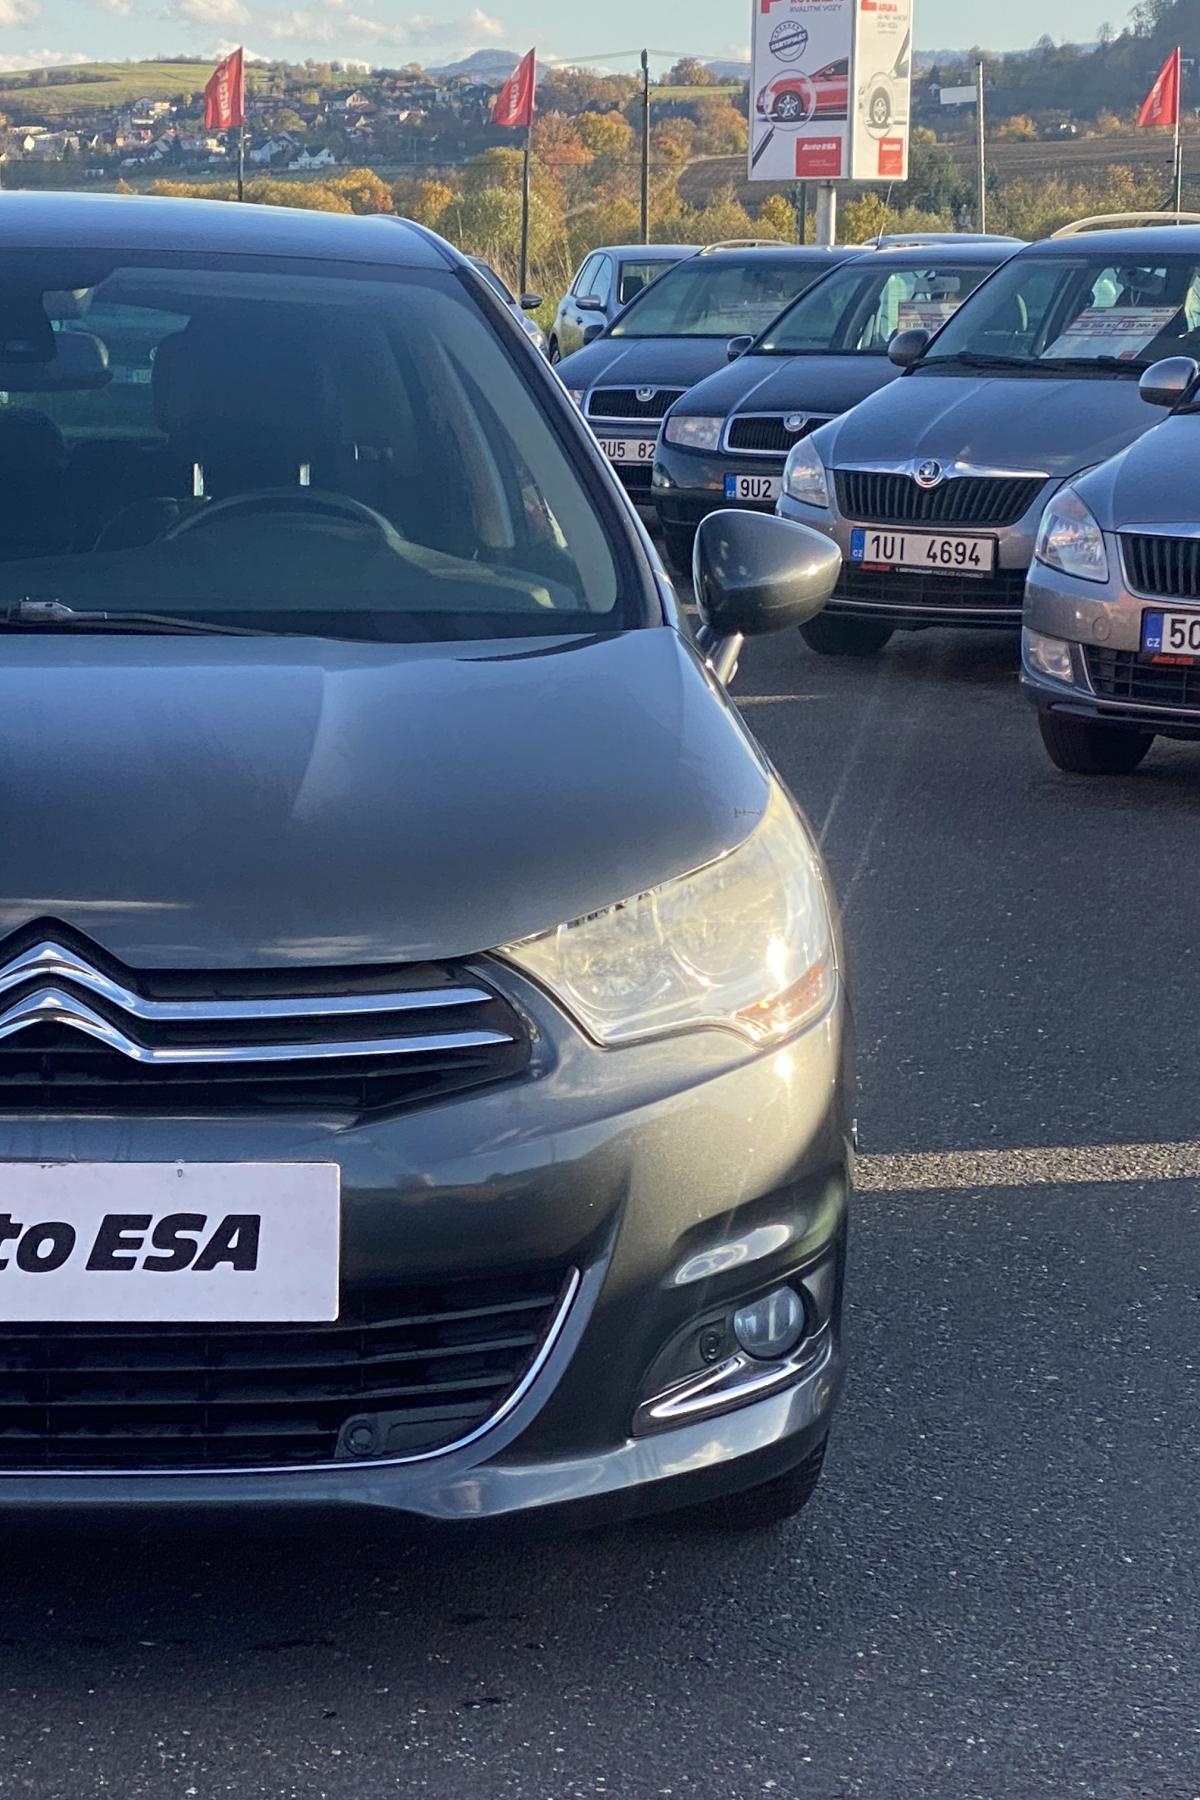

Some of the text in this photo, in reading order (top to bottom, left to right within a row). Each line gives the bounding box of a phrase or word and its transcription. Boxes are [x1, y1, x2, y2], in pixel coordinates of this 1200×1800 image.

[740, 479, 772, 498] 9U2
[852, 535, 981, 566] CZ 1UI 4694
[1146, 638, 1160, 648] CZ
[85, 1212, 262, 1272] ESA
